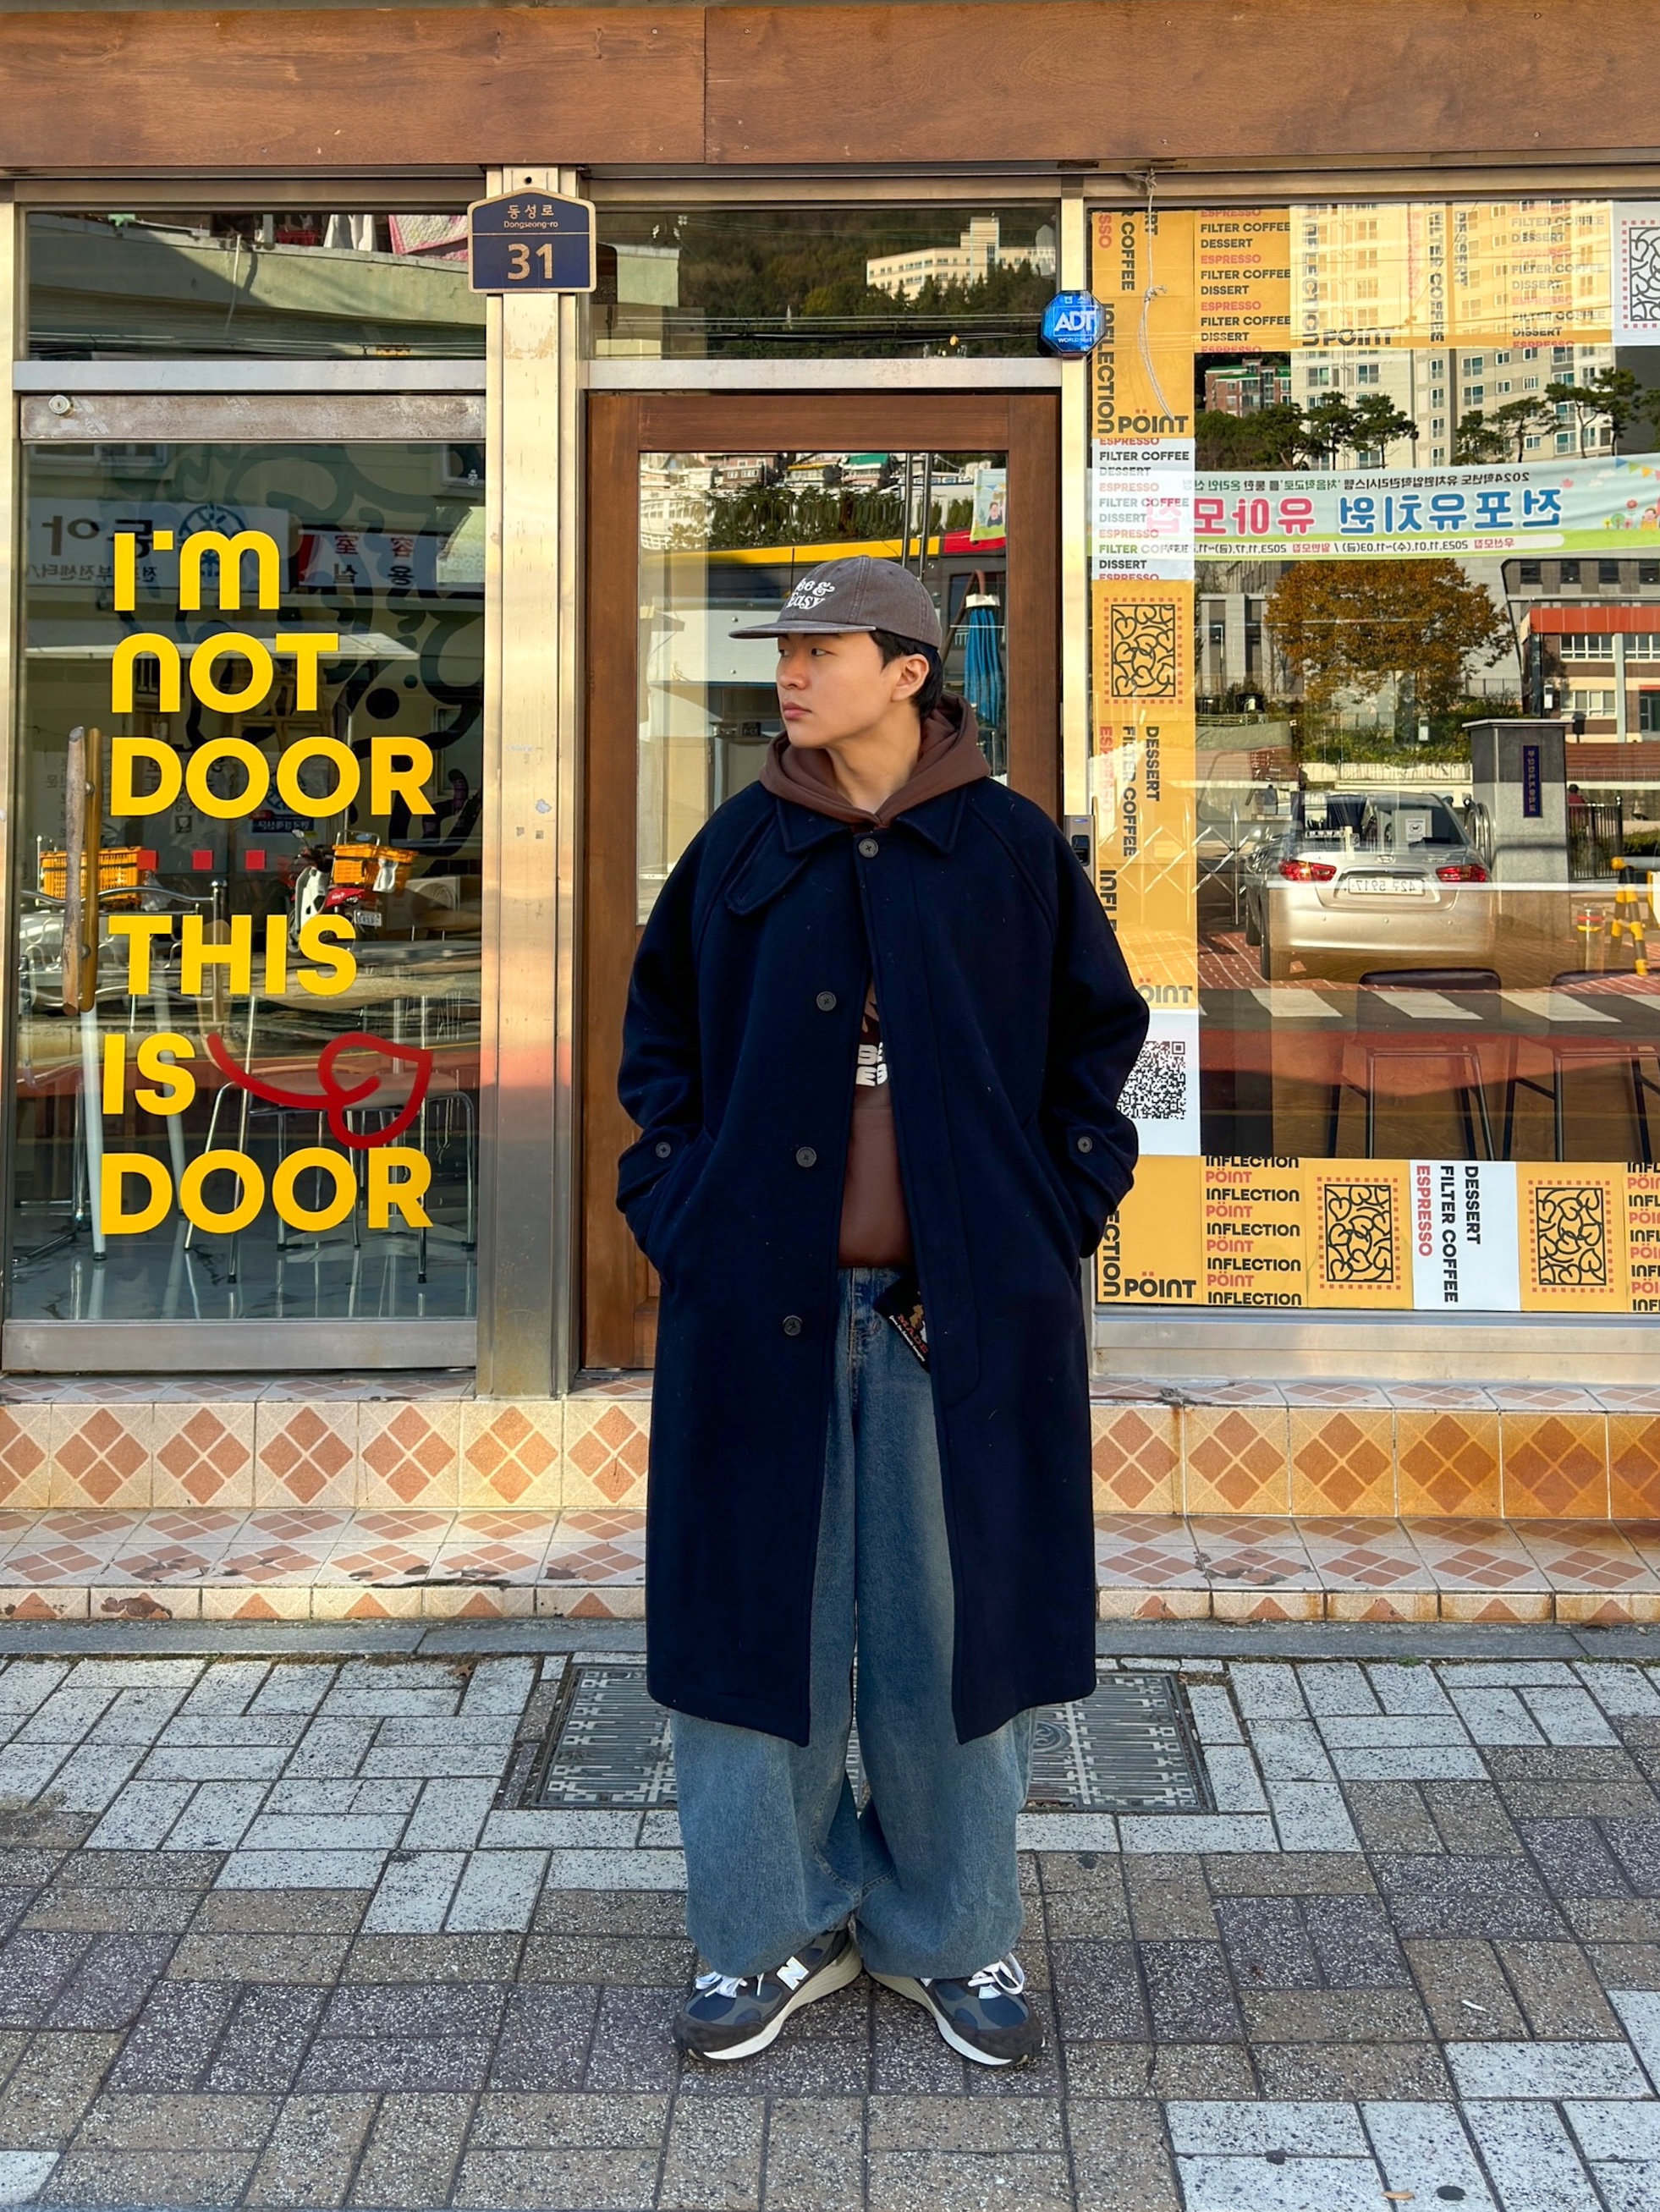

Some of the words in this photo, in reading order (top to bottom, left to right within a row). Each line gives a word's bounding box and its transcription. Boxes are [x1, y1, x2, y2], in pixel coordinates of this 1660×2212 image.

[507, 204, 555, 220] 동성로
[503, 220, 558, 229] Dongseong-ro
[1201, 223, 1240, 233] FILTER
[1243, 222, 1290, 233] COFFEE
[1512, 233, 1564, 243] DESSERT
[1201, 239, 1253, 249] DESSERT
[508, 243, 552, 280] 31
[1121, 222, 1135, 291] COFFEE
[1201, 254, 1261, 264] ESPRESSO
[1512, 264, 1551, 274] FILTER
[1555, 263, 1605, 273] COFFEE
[1201, 270, 1240, 280] FILTER
[1243, 269, 1290, 279] COFFEE
[1512, 279, 1562, 289] DISSERT
[1201, 285, 1250, 295] DISSERT
[1201, 301, 1261, 311] ESPRESSO
[1053, 310, 1096, 332] ADT
[1201, 317, 1240, 327] FILTER
[1243, 316, 1290, 326] COFFEE
[1513, 311, 1552, 321] FILTER
[1201, 332, 1250, 342] DISSERT
[1513, 327, 1562, 337] DISSERT
[1099, 451, 1138, 461] FILTER
[1141, 451, 1190, 460] COFFEE
[1099, 467, 1152, 476] DESSERT
[1099, 482, 1159, 492] ESPRESSO
[1099, 498, 1138, 508] FILTER
[1141, 497, 1190, 507] COFFEE
[1099, 513, 1147, 523] DISSERT
[1099, 529, 1159, 538] ESPRESSO
[1099, 544, 1138, 553] FILTER
[1099, 560, 1147, 569] DISSERT
[812, 581, 835, 596] &
[786, 591, 826, 610] Easy
[1146, 726, 1160, 802] DESSERT
[109, 736, 436, 819] DOOR
[1124, 787, 1137, 857] COFFEE
[108, 914, 357, 996] THIS
[102, 1033, 196, 1116] IS
[100, 1147, 434, 1235] DOOR
[1440, 1165, 1456, 1224] FILTER
[1416, 1165, 1433, 1257] ESPRESSO
[1465, 1166, 1481, 1245] DESSERT
[1442, 1229, 1459, 1303] COFFEE
[776, 1956, 810, 1991] N
